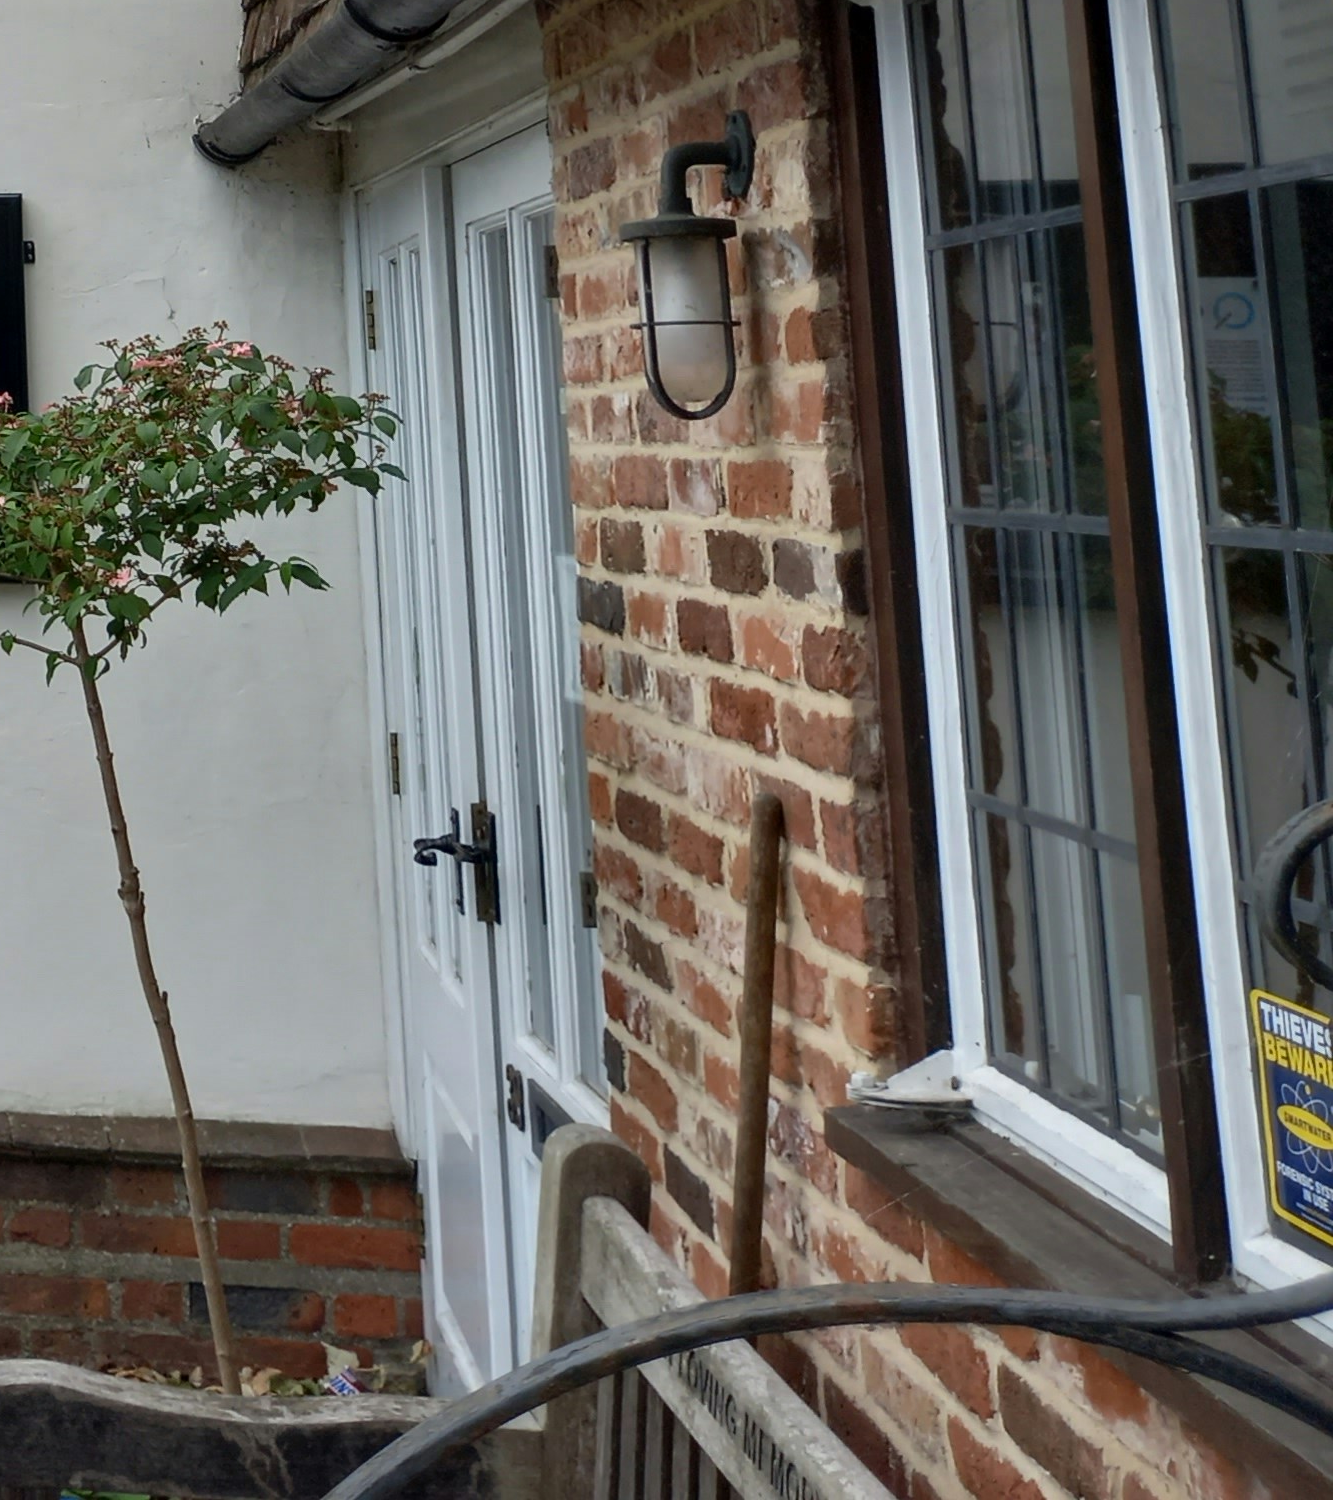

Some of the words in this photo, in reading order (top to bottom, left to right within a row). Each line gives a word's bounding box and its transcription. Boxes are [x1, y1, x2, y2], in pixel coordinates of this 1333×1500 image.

[1284, 1111, 1332, 1141] SMARTWATER
[1277, 1160, 1314, 1190] FORENSIC
[1302, 1187, 1313, 1203] IN
[1312, 1192, 1330, 1213] USE
